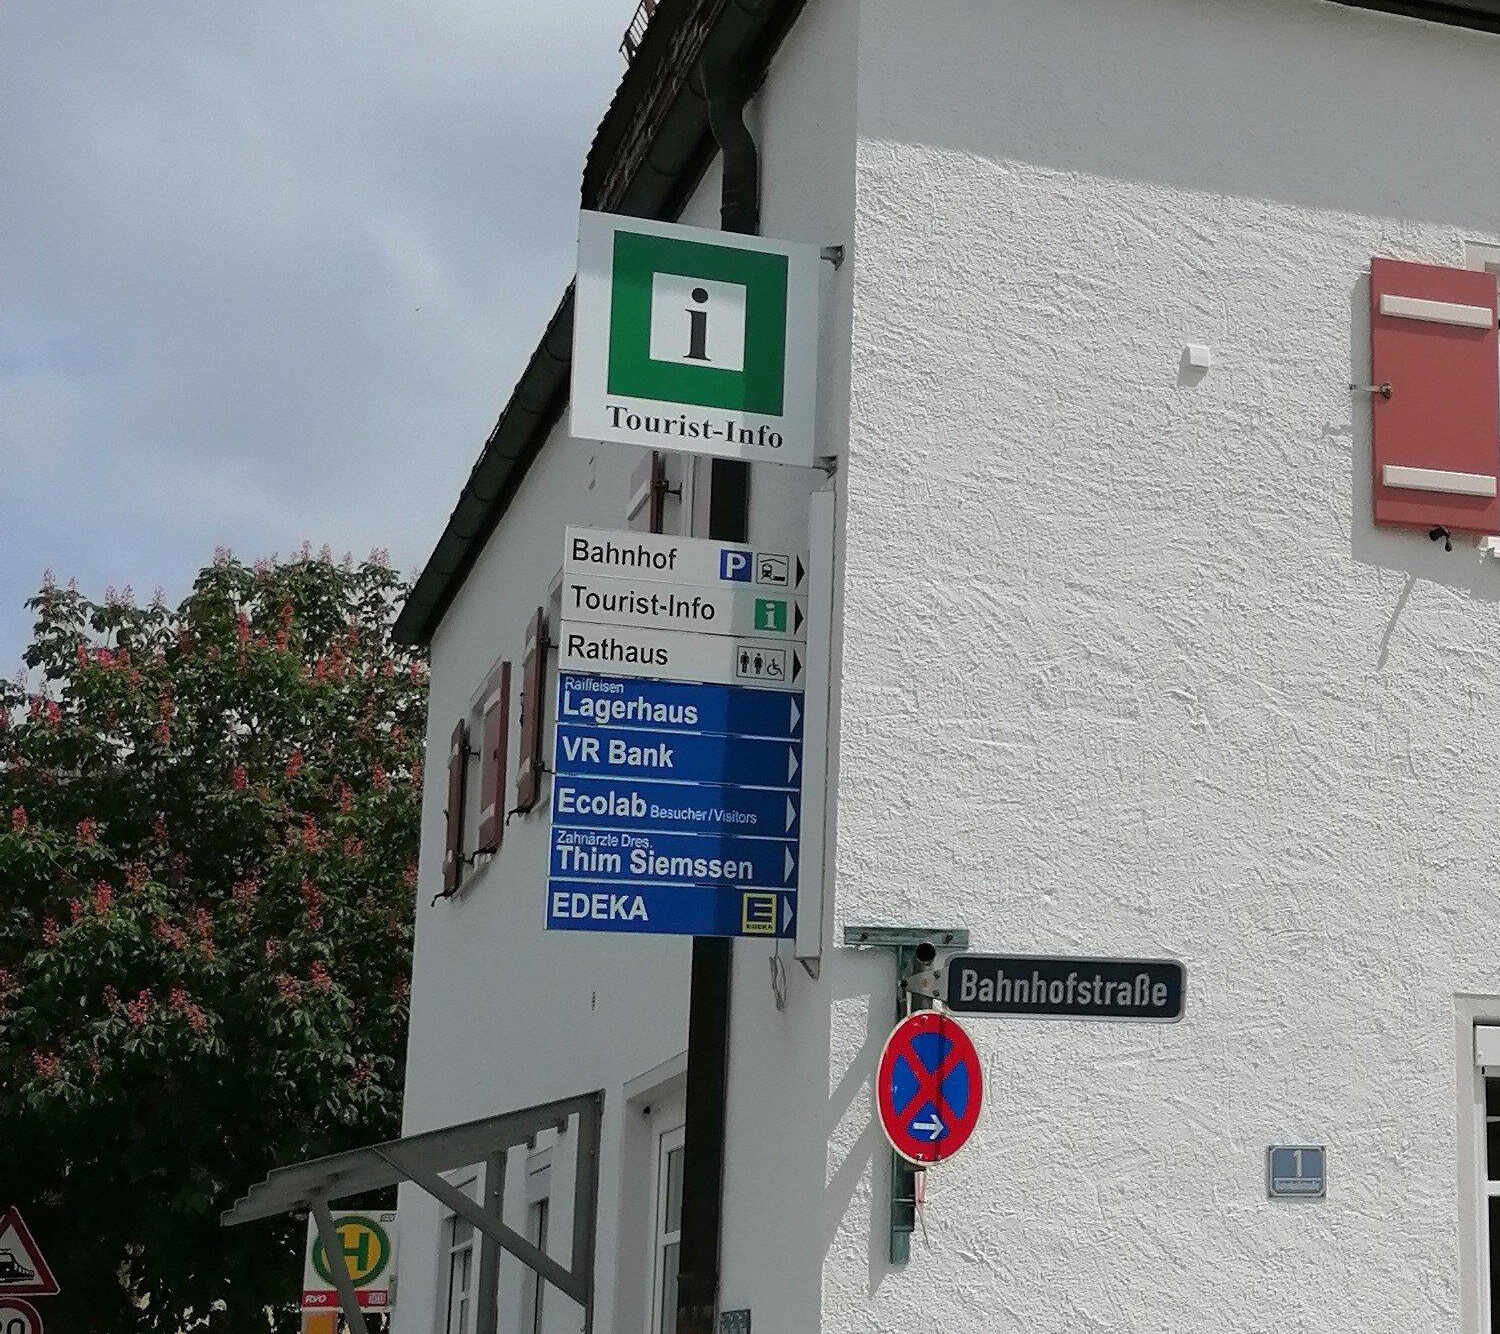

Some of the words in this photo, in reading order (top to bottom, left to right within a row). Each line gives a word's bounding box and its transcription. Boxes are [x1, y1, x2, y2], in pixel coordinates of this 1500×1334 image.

[682, 287, 711, 362] i
[605, 405, 784, 449] Tourist-Info
[572, 538, 678, 570] Bahnhof
[571, 585, 715, 620] Tourist-Info
[568, 634, 668, 665] Rathaus
[565, 676, 624, 694] Raiffeisen
[563, 691, 699, 725] Lagerhaus
[562, 736, 600, 764] VR
[608, 739, 674, 768] Bank
[558, 787, 647, 818] Ecolab
[557, 830, 619, 846] Zahnärzte
[621, 834, 653, 848] Dres.
[556, 845, 621, 872] Thim
[629, 849, 754, 879] Siemssen
[552, 892, 649, 921] EDEKA
[959, 968, 1168, 1007] Bahnhofstraße
[1293, 1149, 1303, 1178] 1
